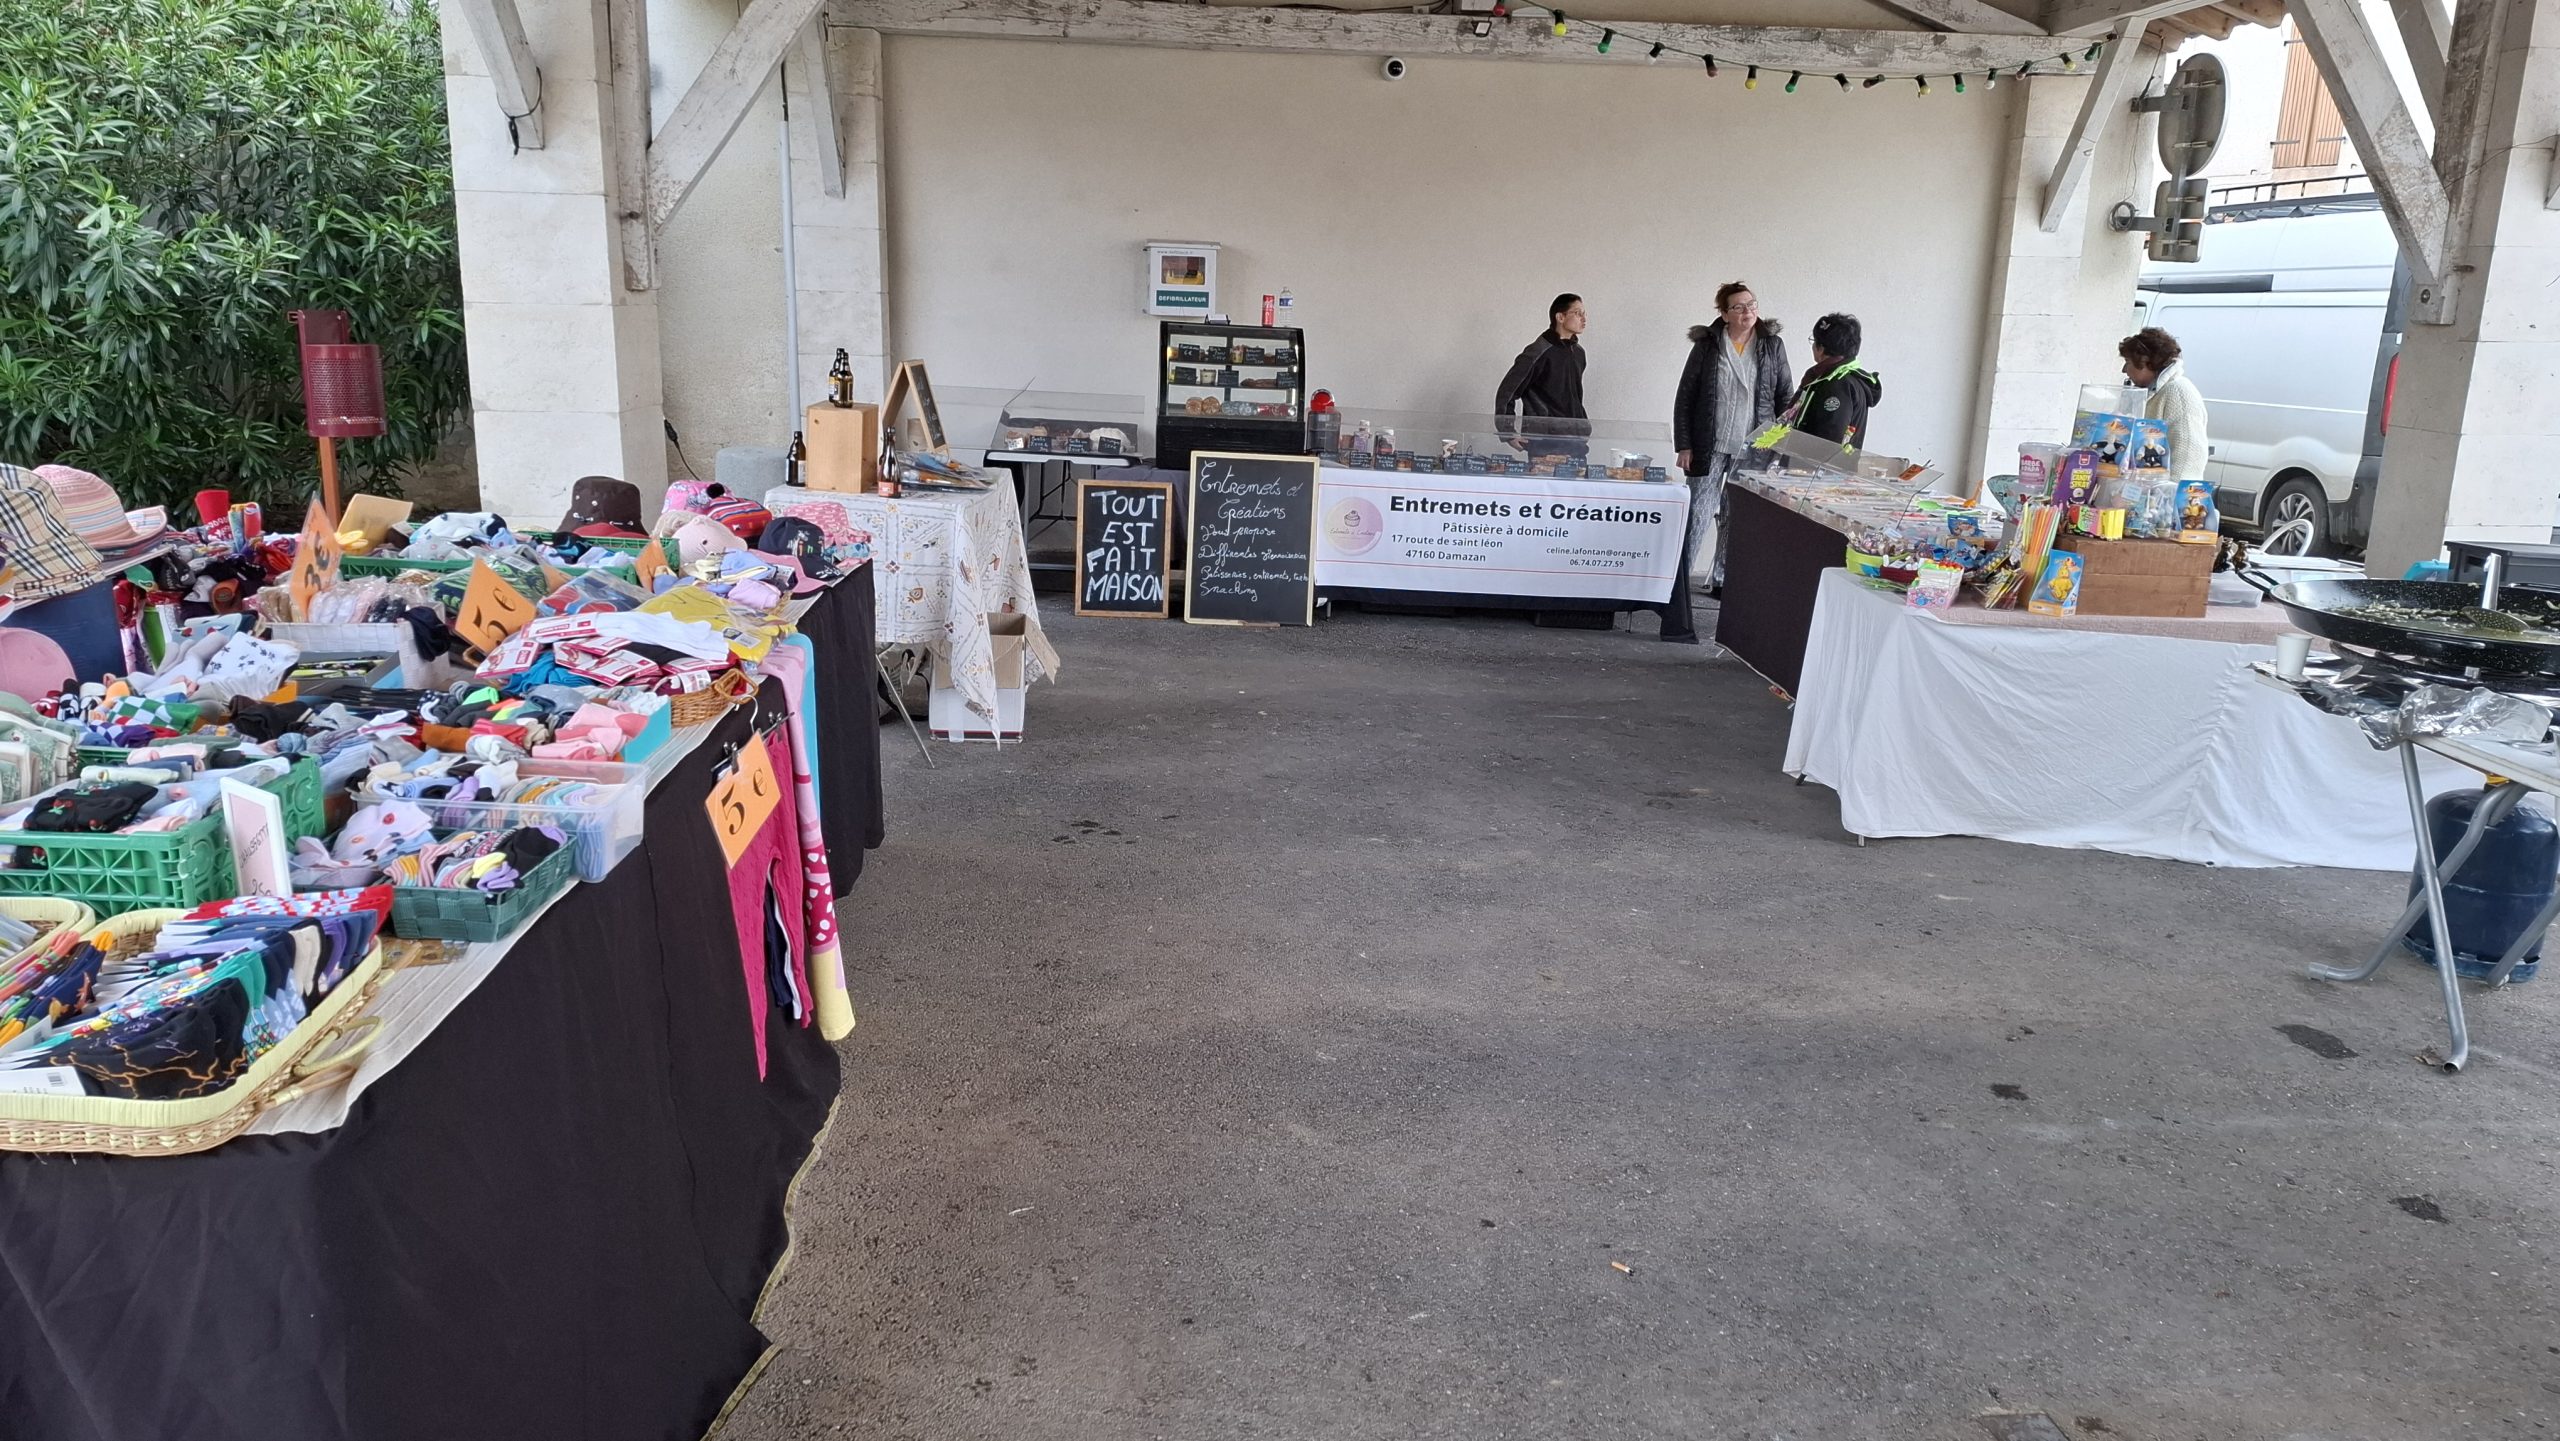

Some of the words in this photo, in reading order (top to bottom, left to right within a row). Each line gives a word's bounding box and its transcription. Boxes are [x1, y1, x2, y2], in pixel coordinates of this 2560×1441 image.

[1158, 295, 1206, 303] DEFIBRILLATEUR
[1200, 461, 1281, 496] Entremets
[1091, 489, 1165, 519] TOUT
[1390, 495, 1511, 518] Entremets
[1519, 503, 1542, 519] et
[1550, 503, 1662, 525] Créations
[1102, 521, 1154, 547] EST
[1233, 526, 1276, 544] propose
[1442, 522, 1503, 535] Pâtissière
[1506, 525, 1513, 535] à
[1517, 525, 1569, 538] domicile
[1391, 535, 1403, 543] 17
[1405, 536, 1434, 545] route
[1437, 536, 1450, 546] de
[1452, 538, 1478, 547] saint
[1481, 538, 1503, 548] léon
[1405, 550, 1435, 560] 47160
[1438, 550, 1486, 562] Damazan
[1546, 547, 1650, 560] celine.lafontan@orange.fr
[1569, 558, 1624, 568] 06.74.07.27.59
